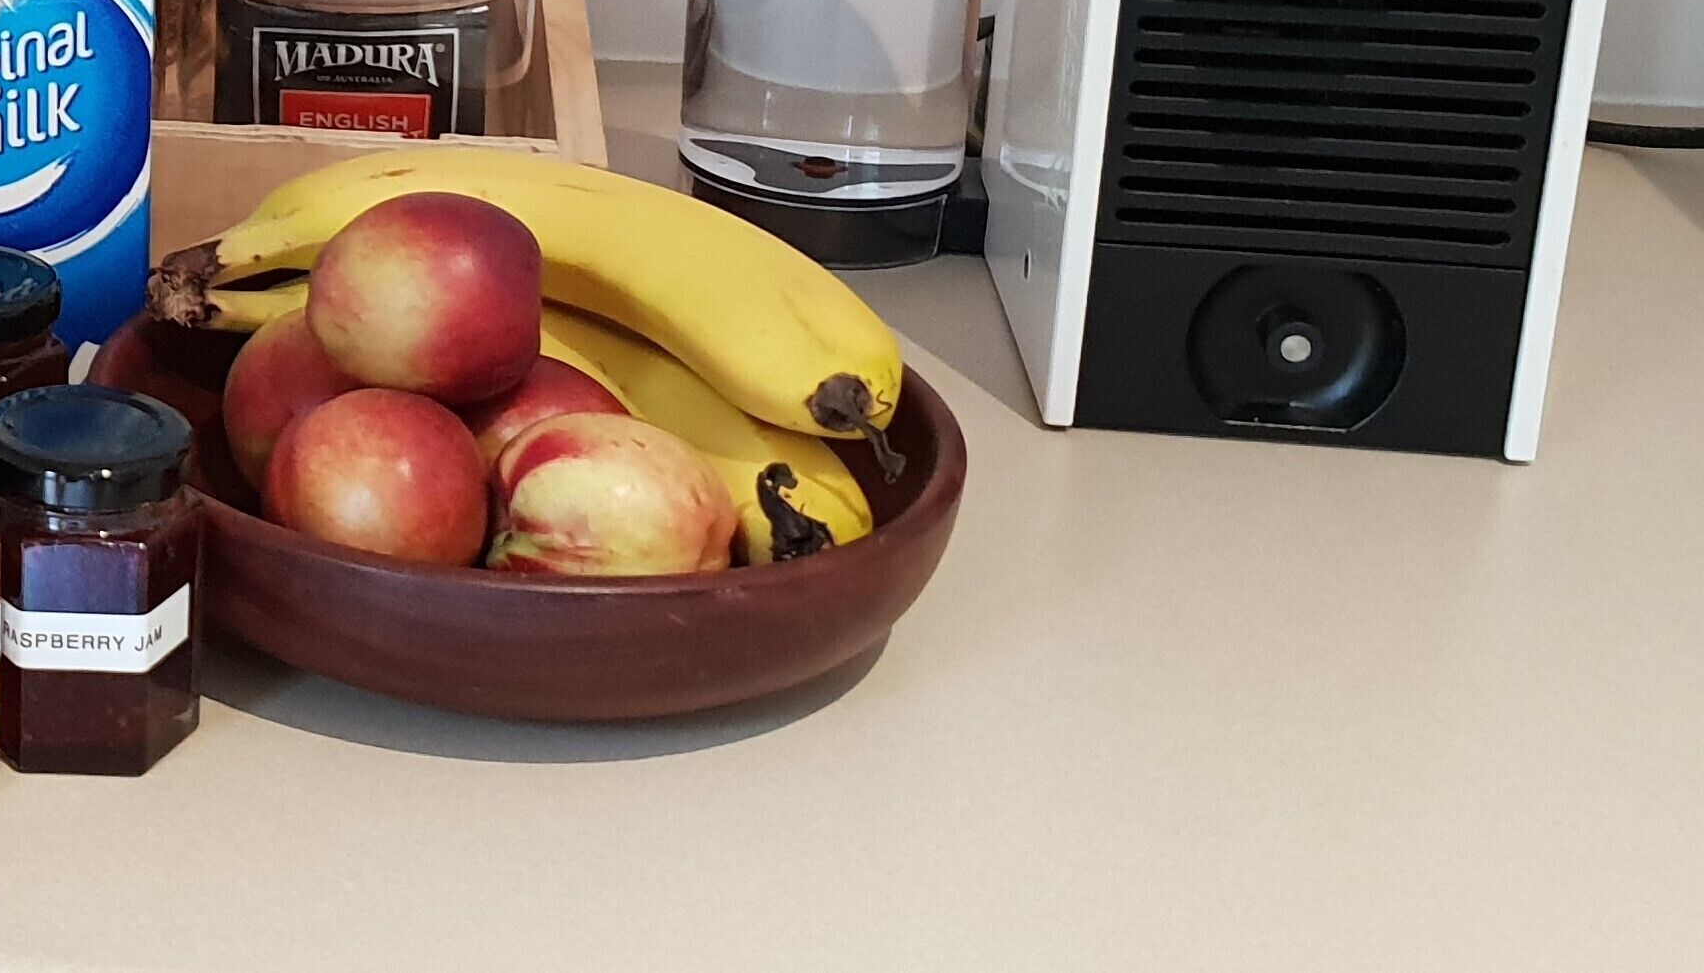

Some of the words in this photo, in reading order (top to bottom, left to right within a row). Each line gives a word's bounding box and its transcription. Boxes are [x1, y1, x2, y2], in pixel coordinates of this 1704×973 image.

[273, 39, 440, 88] MADURA
[299, 111, 409, 131] ENGLISH
[2, 620, 125, 653] RASPBERRY
[134, 624, 164, 653] JAM
